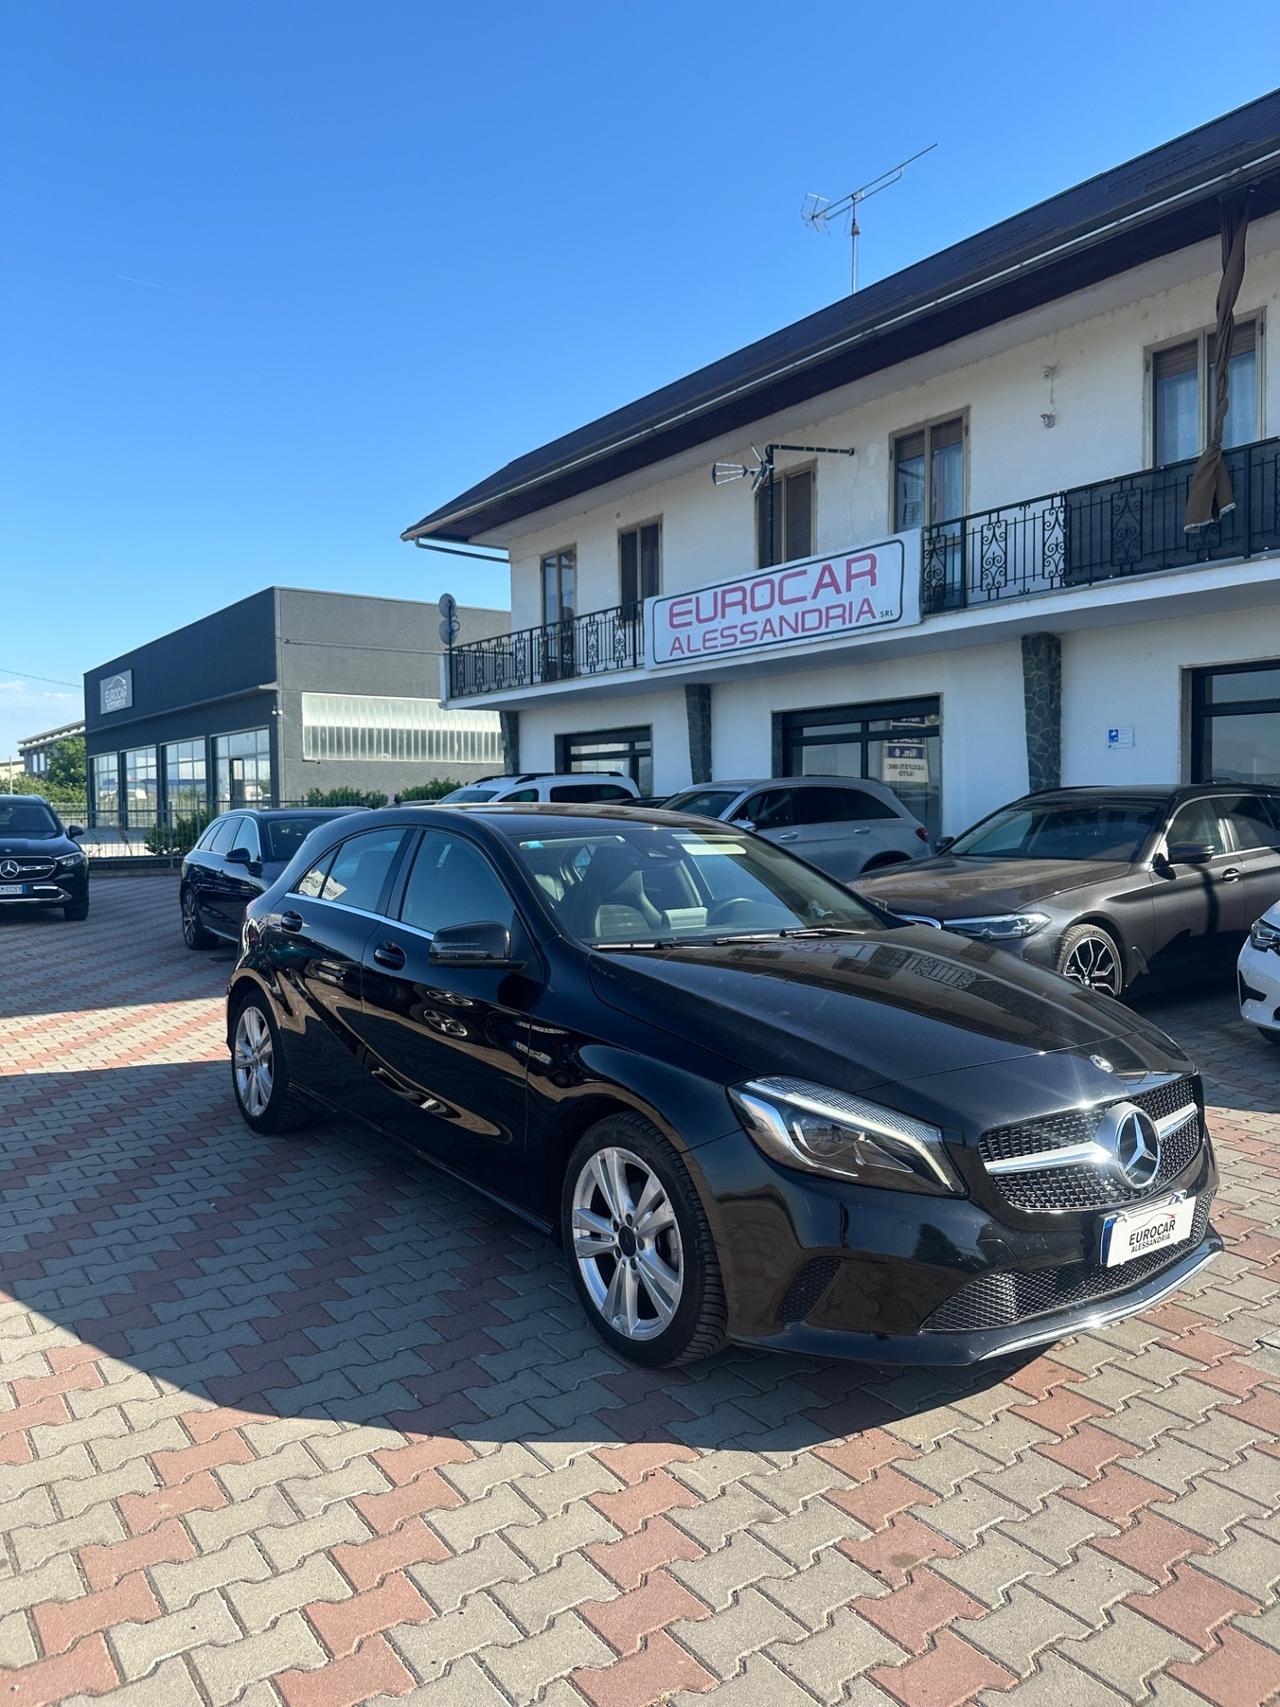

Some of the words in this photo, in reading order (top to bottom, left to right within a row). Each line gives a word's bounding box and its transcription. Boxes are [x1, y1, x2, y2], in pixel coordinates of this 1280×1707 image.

[668, 552, 877, 630] EUROCAR
[669, 597, 876, 657] ALESSANDRIA
[880, 609, 894, 618] SRL
[1128, 1219, 1176, 1247] EUROCAR
[1130, 1233, 1171, 1254] ALESSANDRIA
